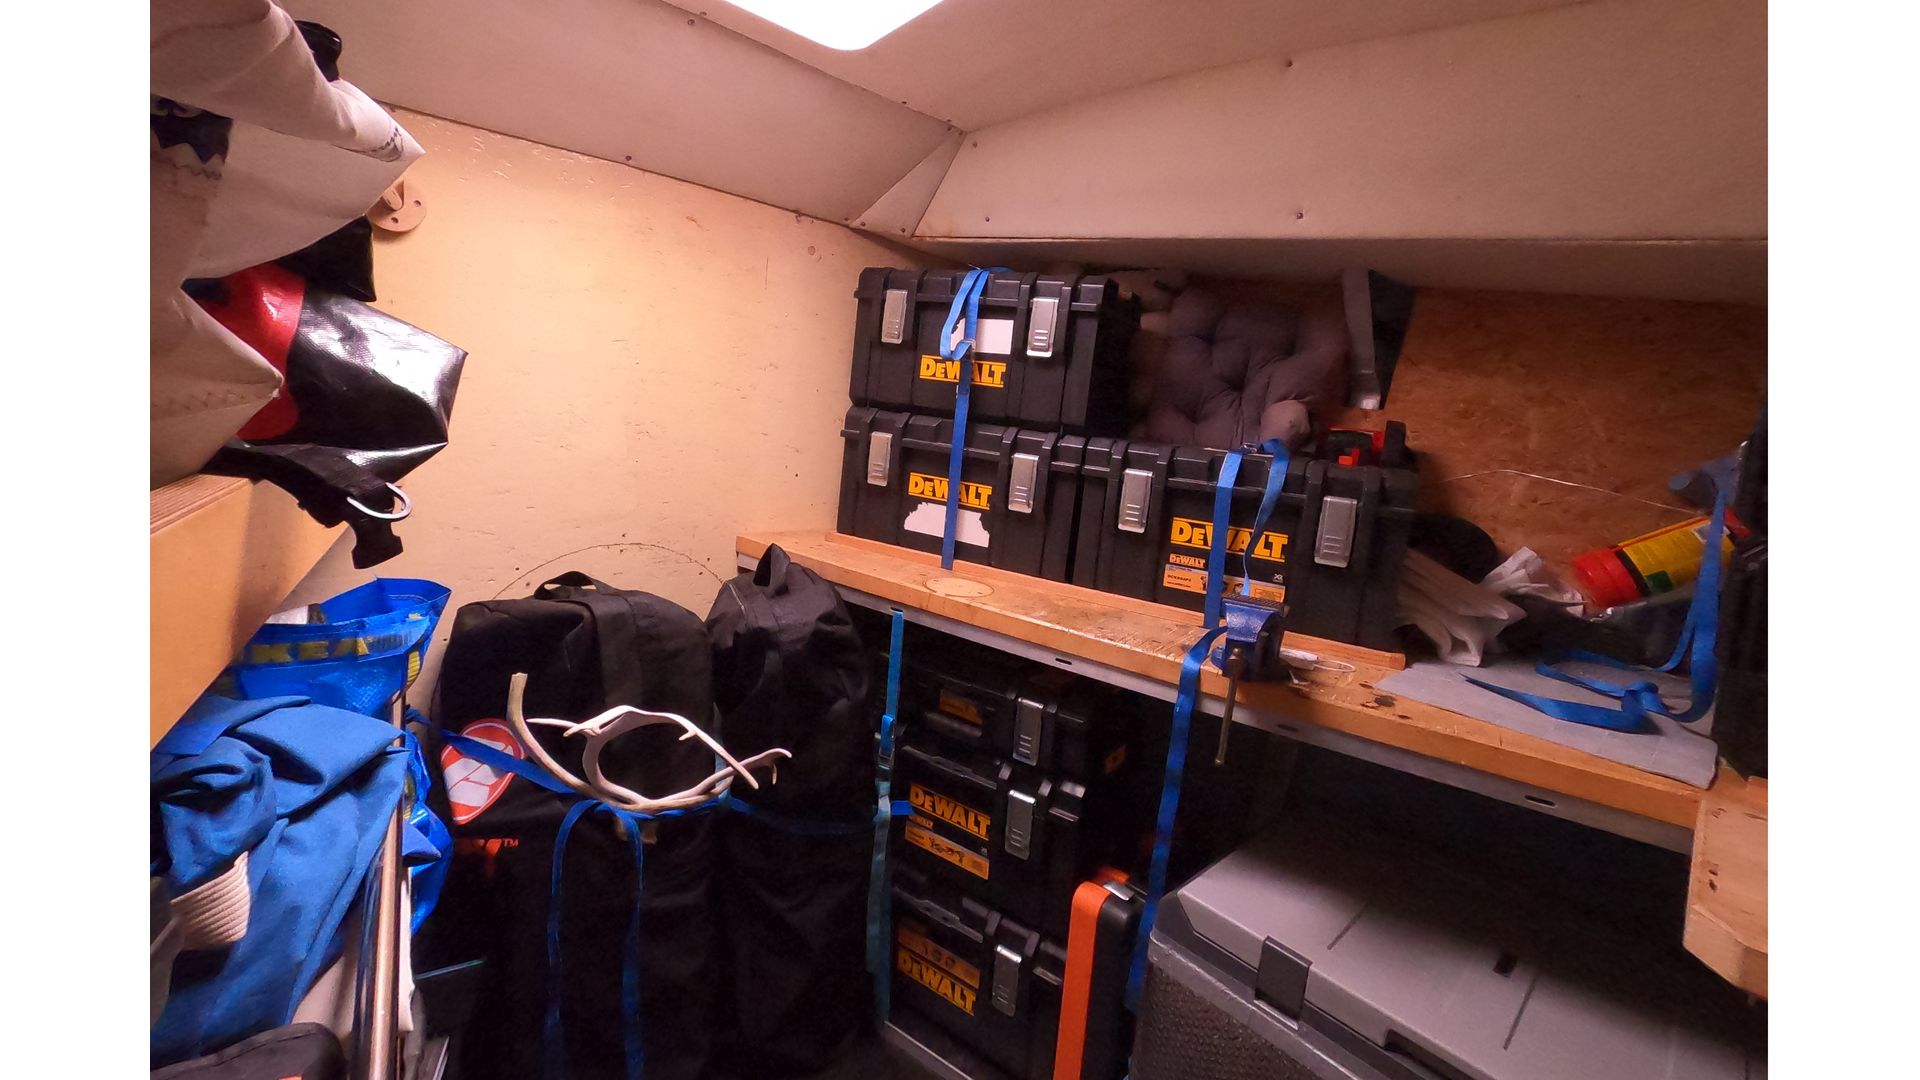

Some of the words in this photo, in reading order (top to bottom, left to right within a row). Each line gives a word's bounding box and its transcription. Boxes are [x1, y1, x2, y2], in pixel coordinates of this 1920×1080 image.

[233, 637, 371, 665] KEA
[910, 783, 991, 840] DEWALT
[898, 950, 977, 1016] DEWALT
